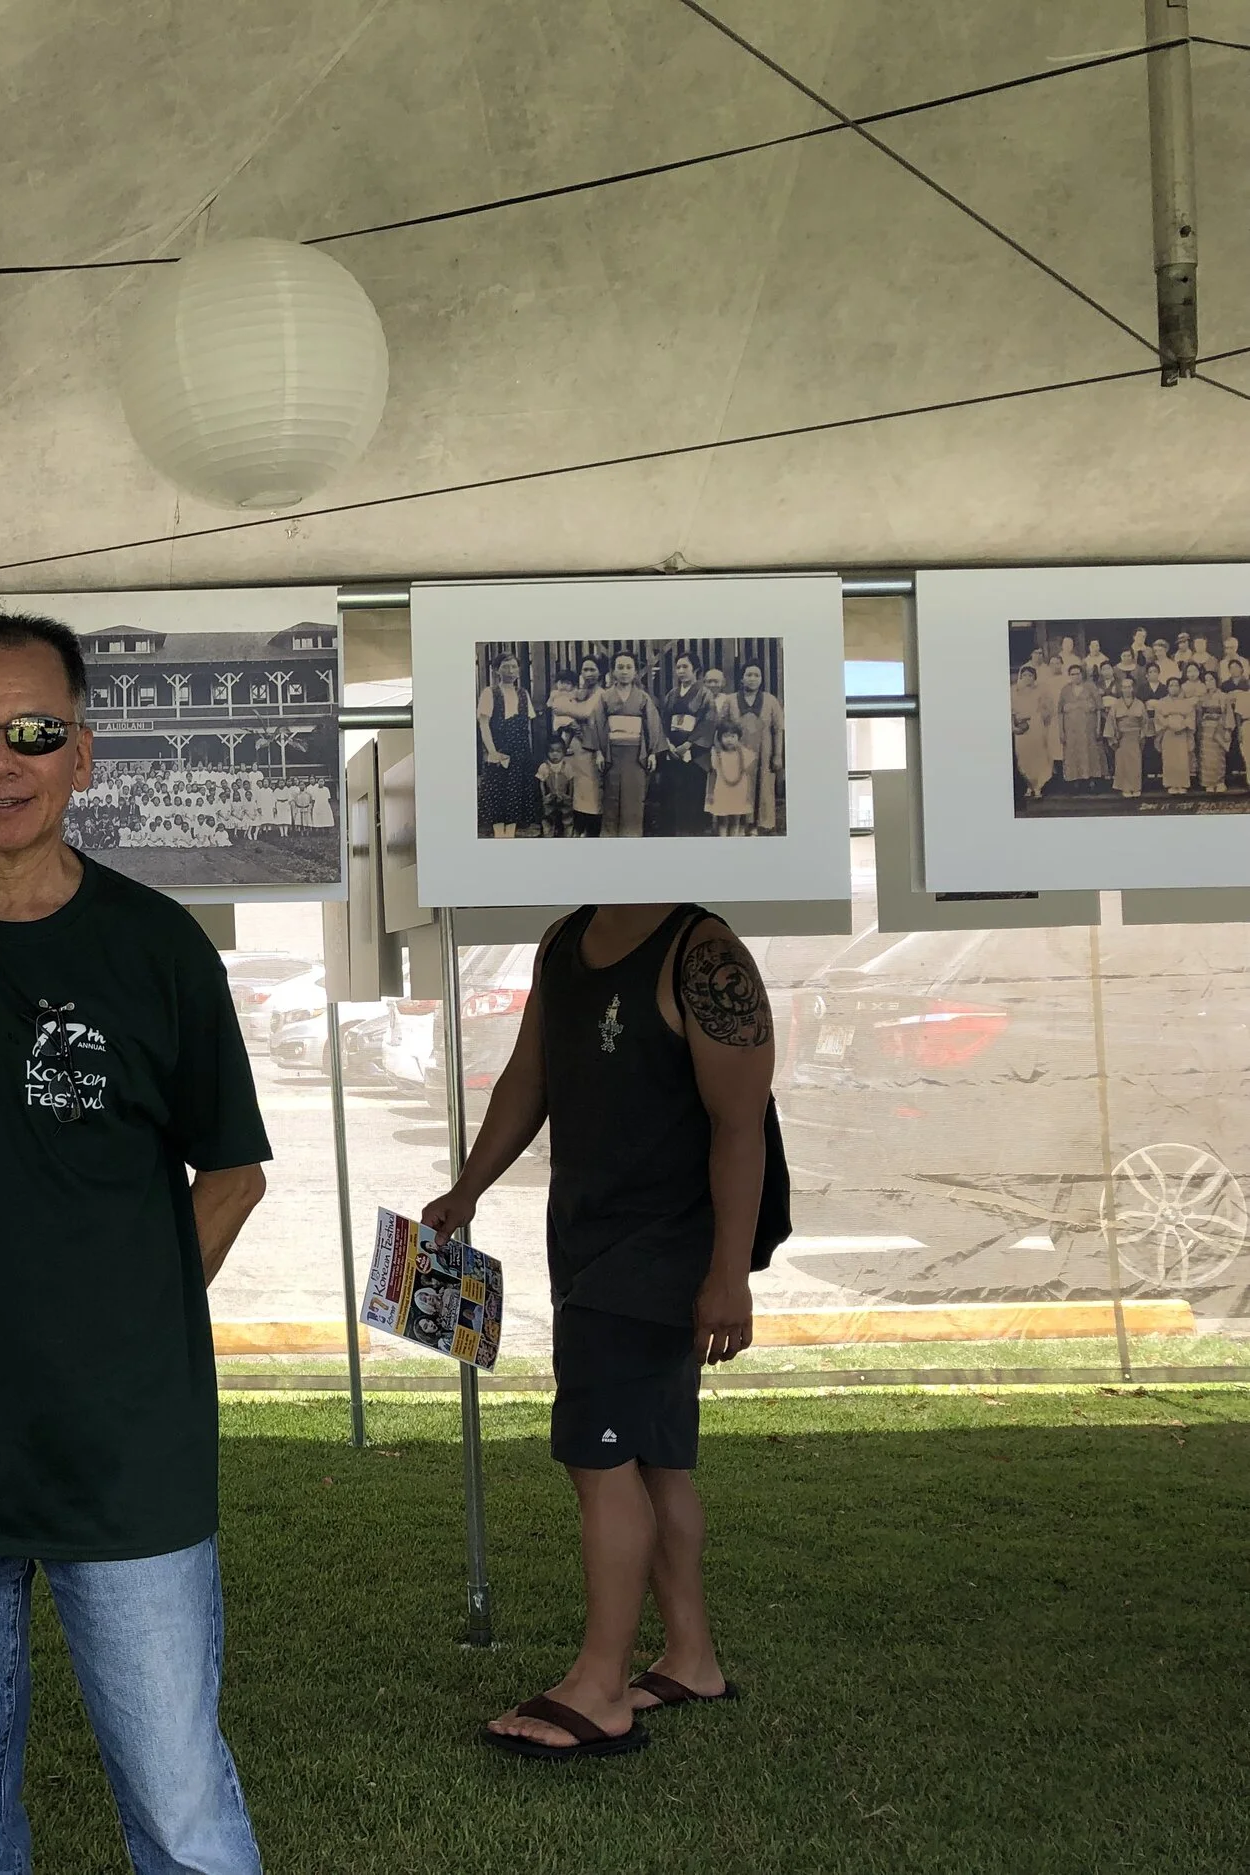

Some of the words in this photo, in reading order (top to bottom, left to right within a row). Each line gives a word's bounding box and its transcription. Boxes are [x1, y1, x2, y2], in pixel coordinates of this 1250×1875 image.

[78, 1042, 106, 1052] ANNUAL
[25, 1084, 105, 1109] Fesval
[373, 1255, 390, 1297] Korean
[382, 1212, 395, 1250] Festival
